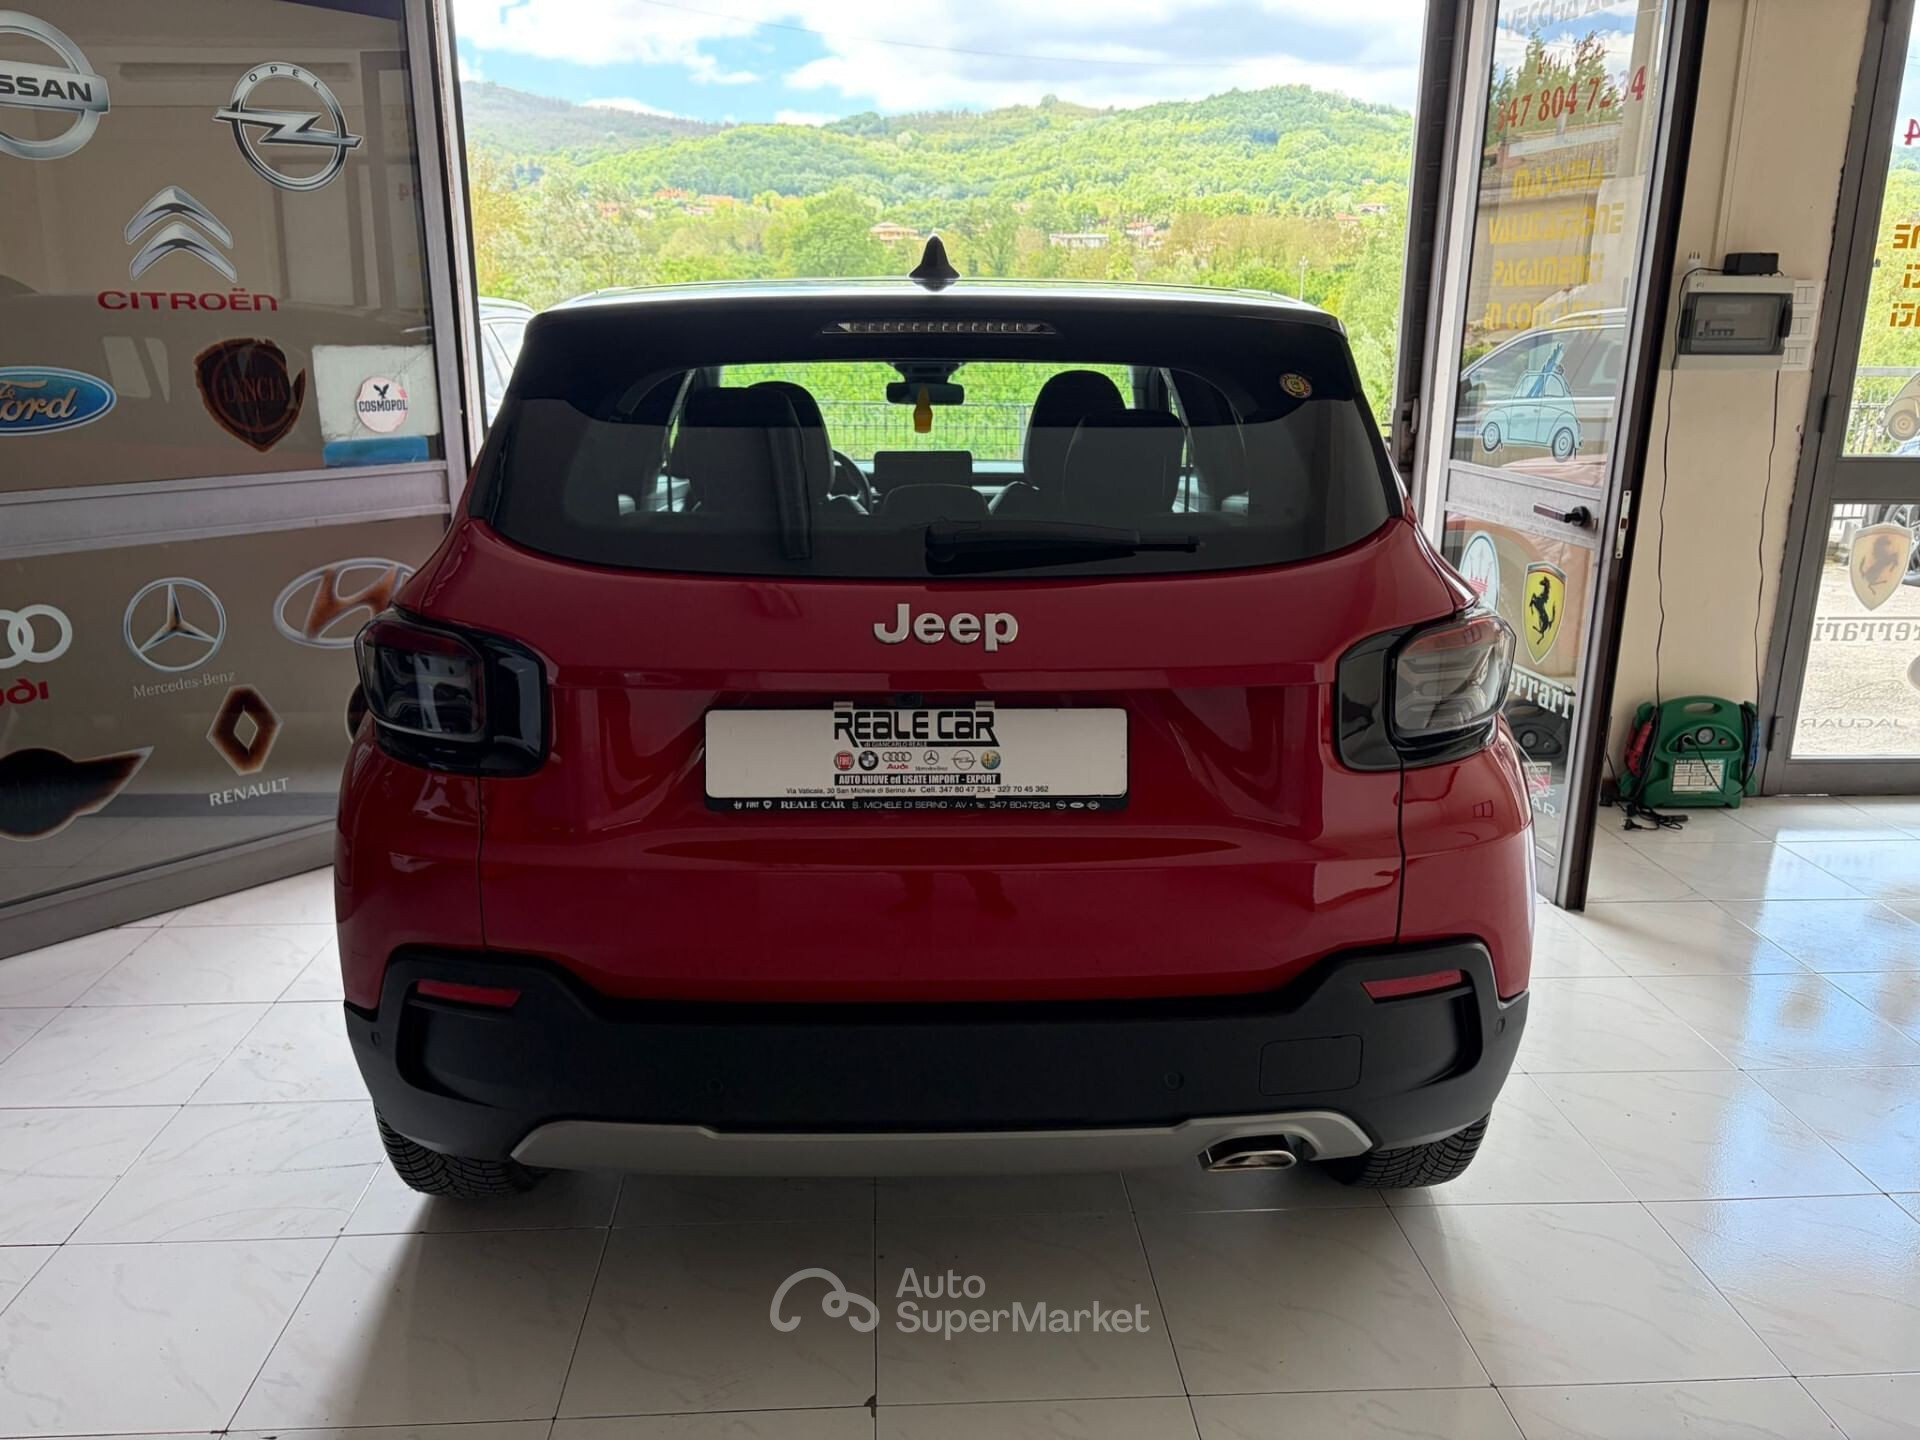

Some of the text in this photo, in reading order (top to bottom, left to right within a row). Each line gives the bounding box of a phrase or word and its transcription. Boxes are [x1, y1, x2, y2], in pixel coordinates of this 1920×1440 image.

[0, 74, 92, 102] SSAN
[249, 66, 321, 90] OPEL
[1538, 82, 1578, 121] 804
[358, 399, 408, 413] COSMOPOL
[873, 602, 1019, 652] Jeep
[0, 678, 49, 705] di
[132, 671, 236, 699] Mercedes-Benz
[1507, 670, 1571, 719] errari
[209, 777, 290, 807] RENAULT
[839, 774, 861, 784] AUTO
[862, 774, 889, 784] NUOVE
[890, 774, 900, 784] ed
[902, 774, 927, 784] USATE
[929, 774, 960, 784] IMPORT
[966, 774, 997, 784] EXPORT
[850, 786, 876, 794] Michele
[977, 785, 990, 793] 234
[1013, 785, 1022, 793] 70
[780, 801, 818, 809] REALE
[821, 801, 846, 809] CAR
[863, 801, 902, 809] MICHELE
[904, 801, 913, 809] DI
[915, 801, 948, 809] SERINO
[955, 801, 967, 809] AV
[989, 801, 1007, 809] 347
[1009, 801, 1051, 809] 8047234
